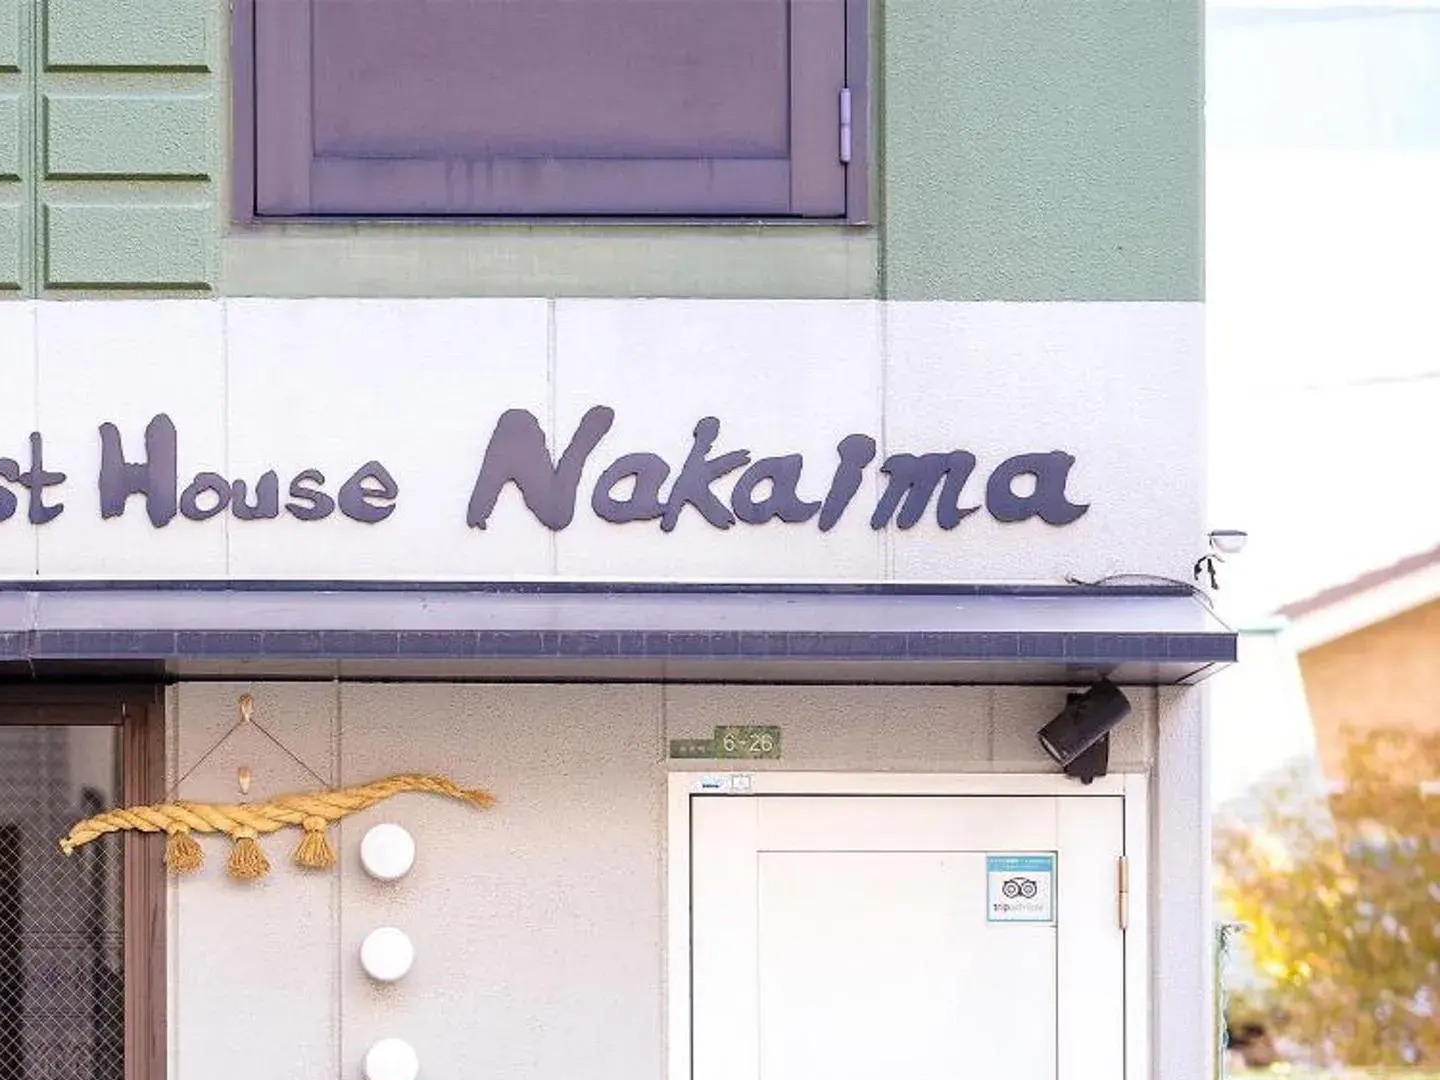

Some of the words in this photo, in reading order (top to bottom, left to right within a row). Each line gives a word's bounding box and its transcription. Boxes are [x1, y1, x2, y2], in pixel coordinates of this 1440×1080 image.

[97, 412, 399, 528] House
[465, 404, 1092, 533] Nakaima
[722, 732, 774, 753] 6-26
